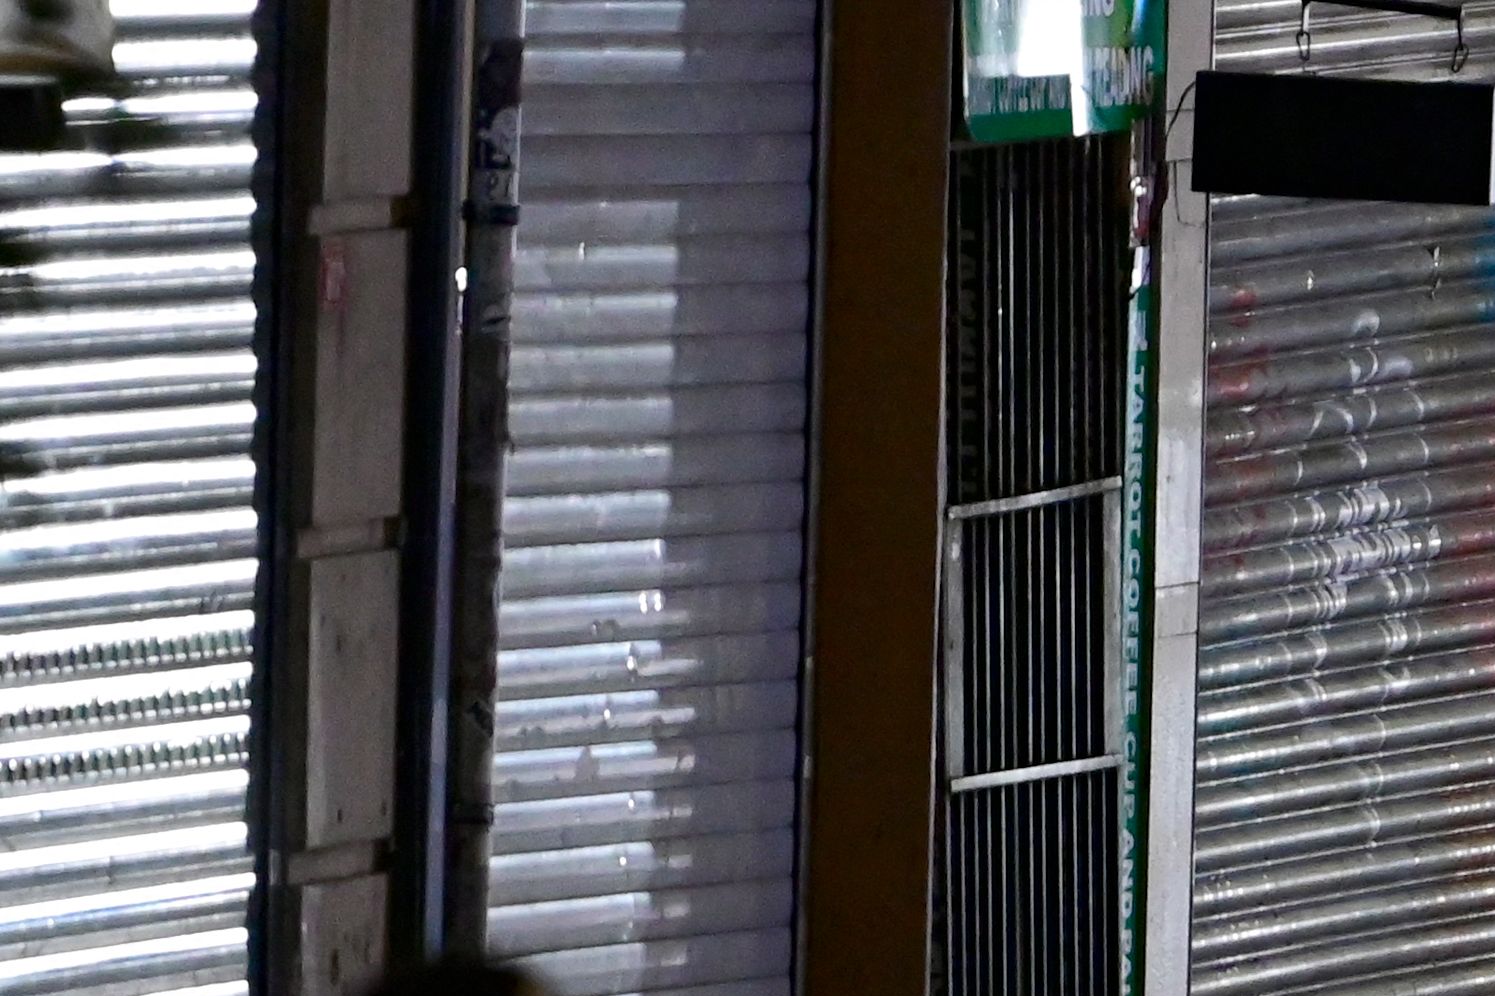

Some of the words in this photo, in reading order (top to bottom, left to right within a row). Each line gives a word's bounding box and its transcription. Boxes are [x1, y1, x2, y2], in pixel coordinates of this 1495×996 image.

[1126, 365, 1145, 539] TARROT
[1123, 548, 1141, 715] COFFEE
[1122, 732, 1136, 819] CUP
[1120, 828, 1135, 919] AND
